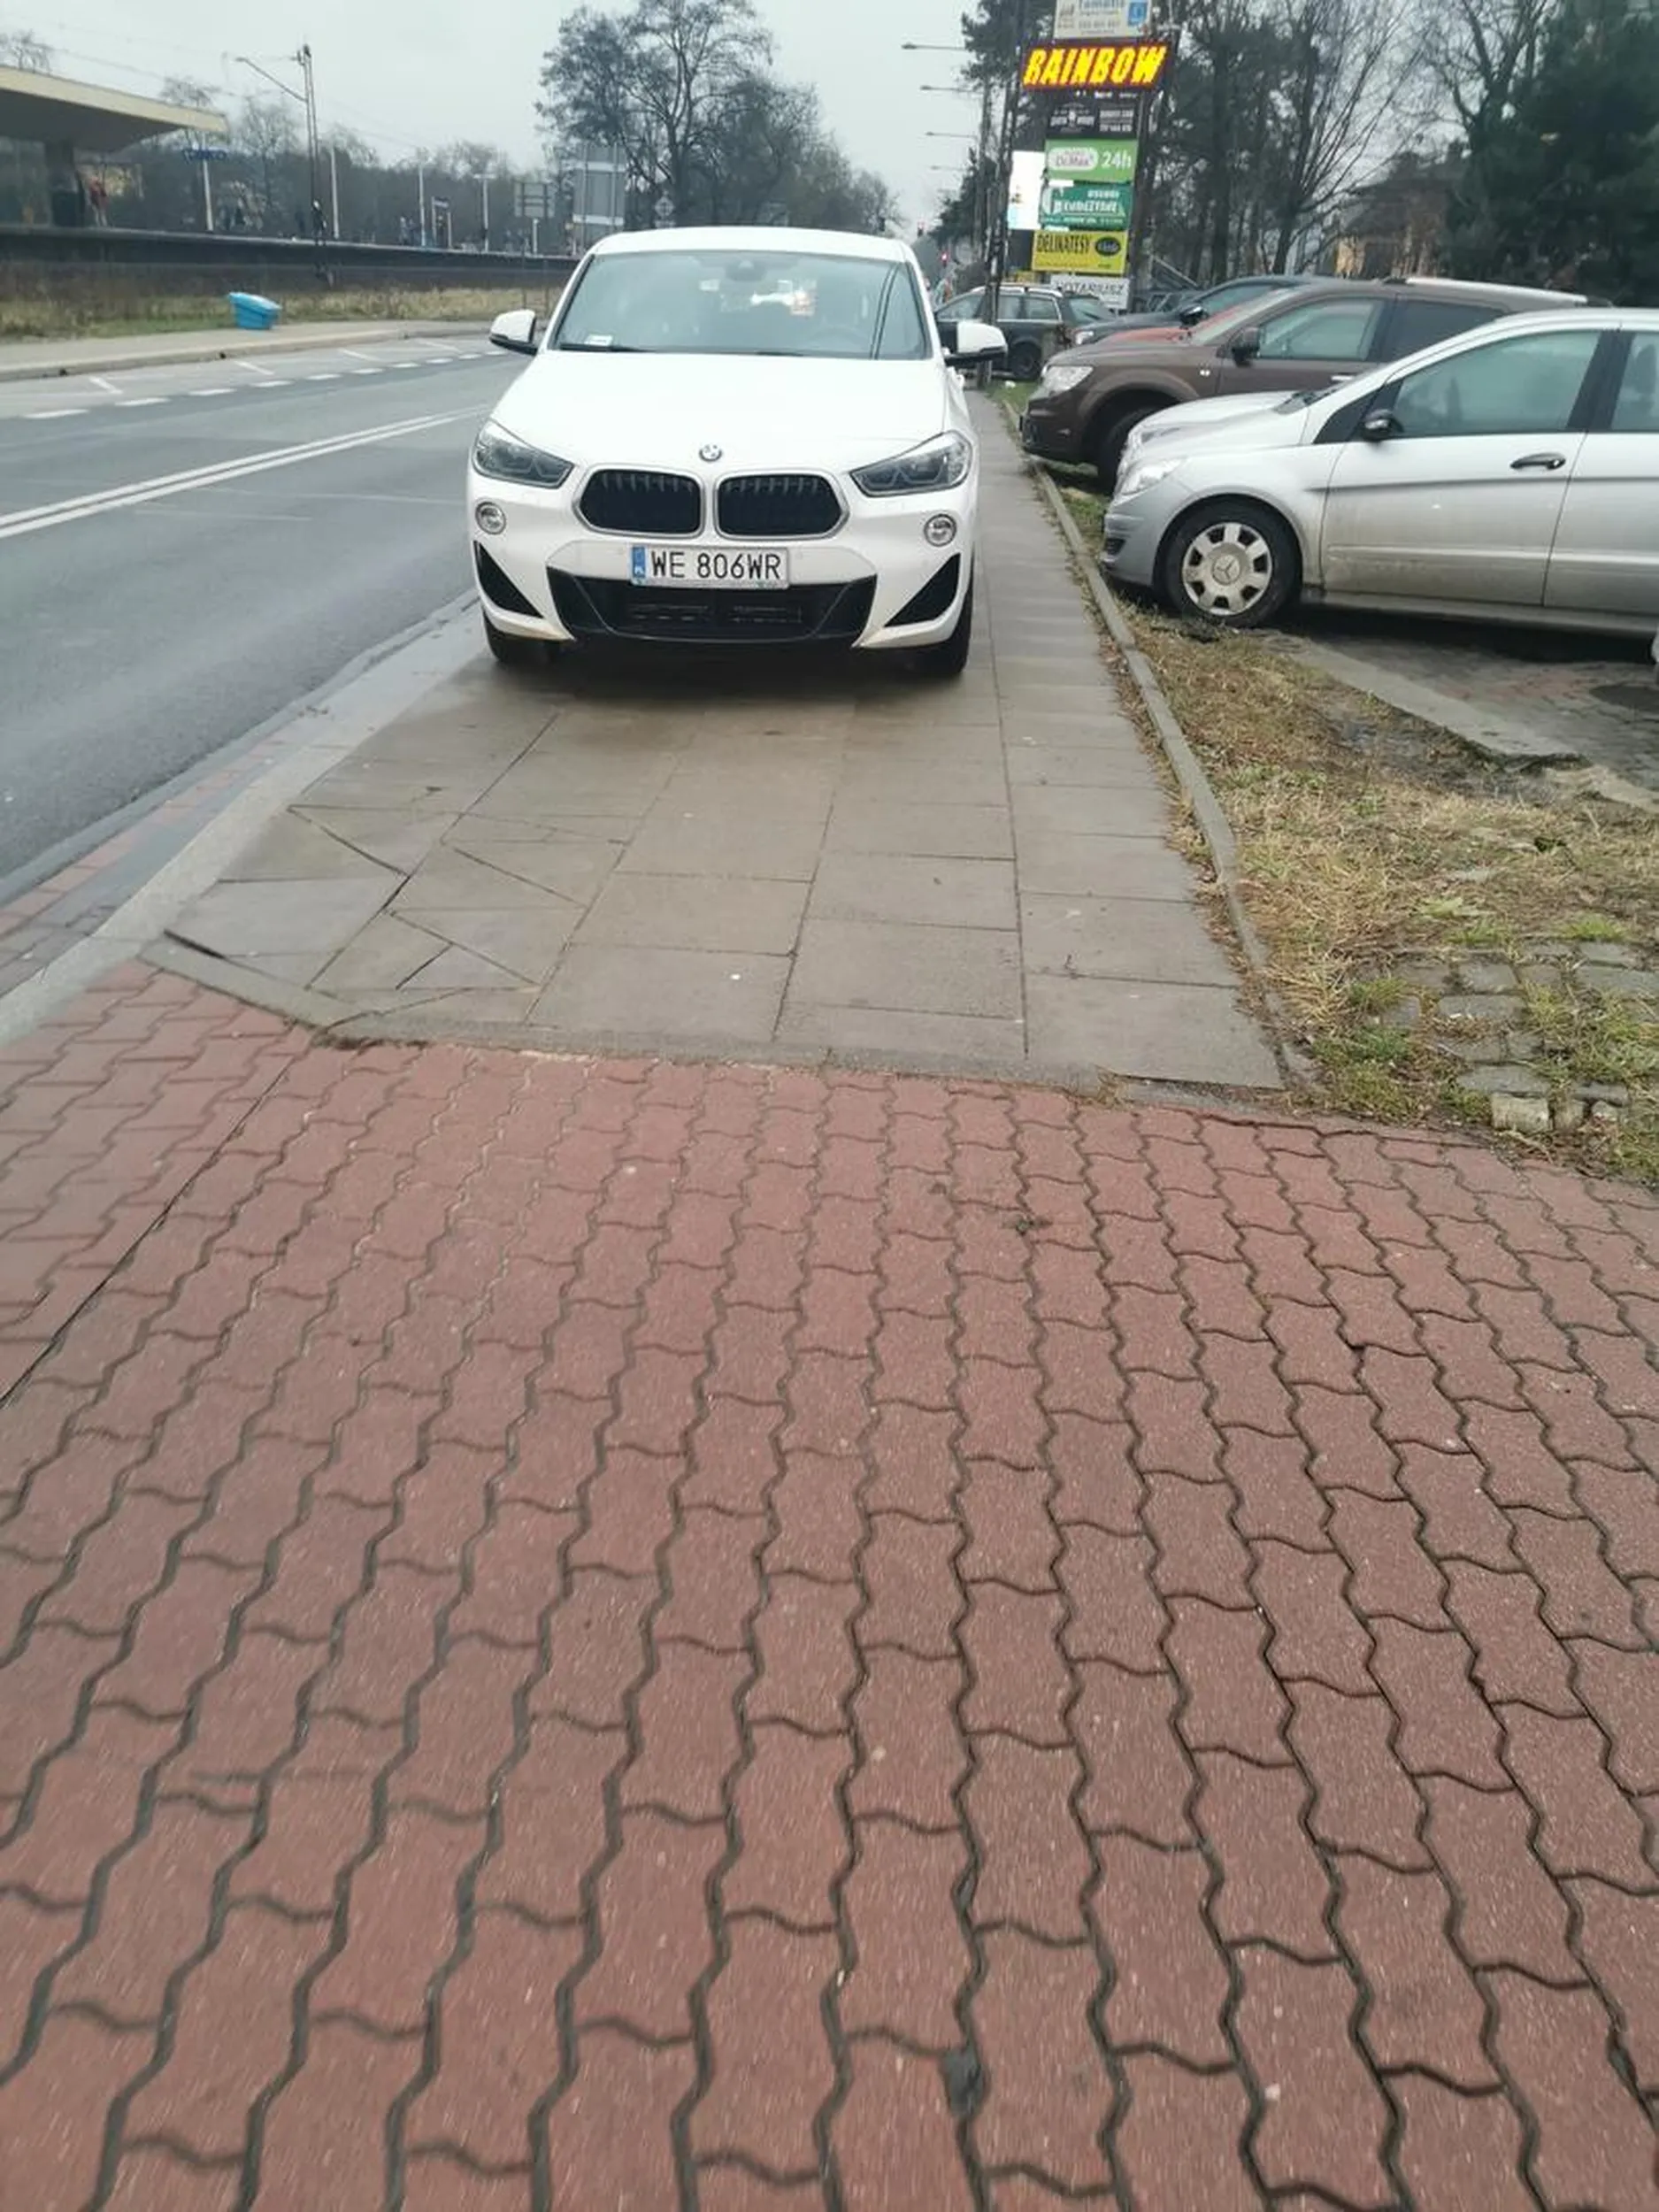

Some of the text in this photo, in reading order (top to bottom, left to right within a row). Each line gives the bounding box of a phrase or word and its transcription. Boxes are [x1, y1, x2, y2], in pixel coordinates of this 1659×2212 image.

[1023, 46, 1167, 86] RAINBOW
[1101, 150, 1132, 170] 24h
[1036, 234, 1090, 254] DELIKATESY
[651, 551, 685, 577] WE
[696, 552, 781, 579] 806WR
